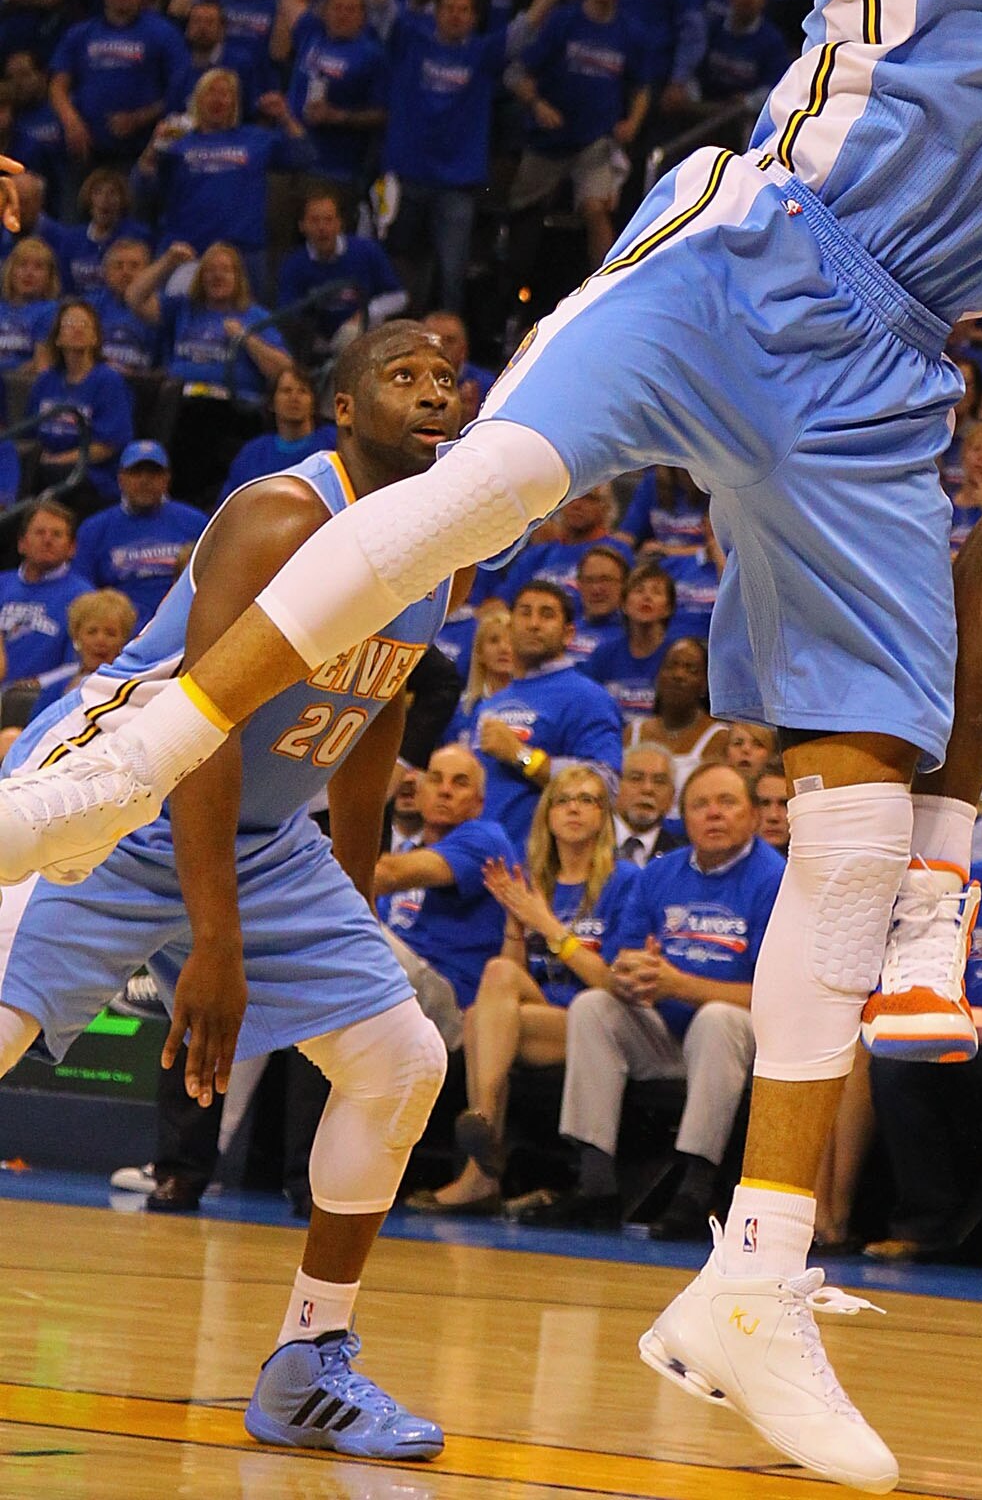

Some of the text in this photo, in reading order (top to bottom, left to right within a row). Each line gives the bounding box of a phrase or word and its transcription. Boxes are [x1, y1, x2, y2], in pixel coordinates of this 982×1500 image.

[305, 635, 428, 700] ENVE
[271, 701, 369, 767] 20
[728, 1304, 761, 1336] KJ
